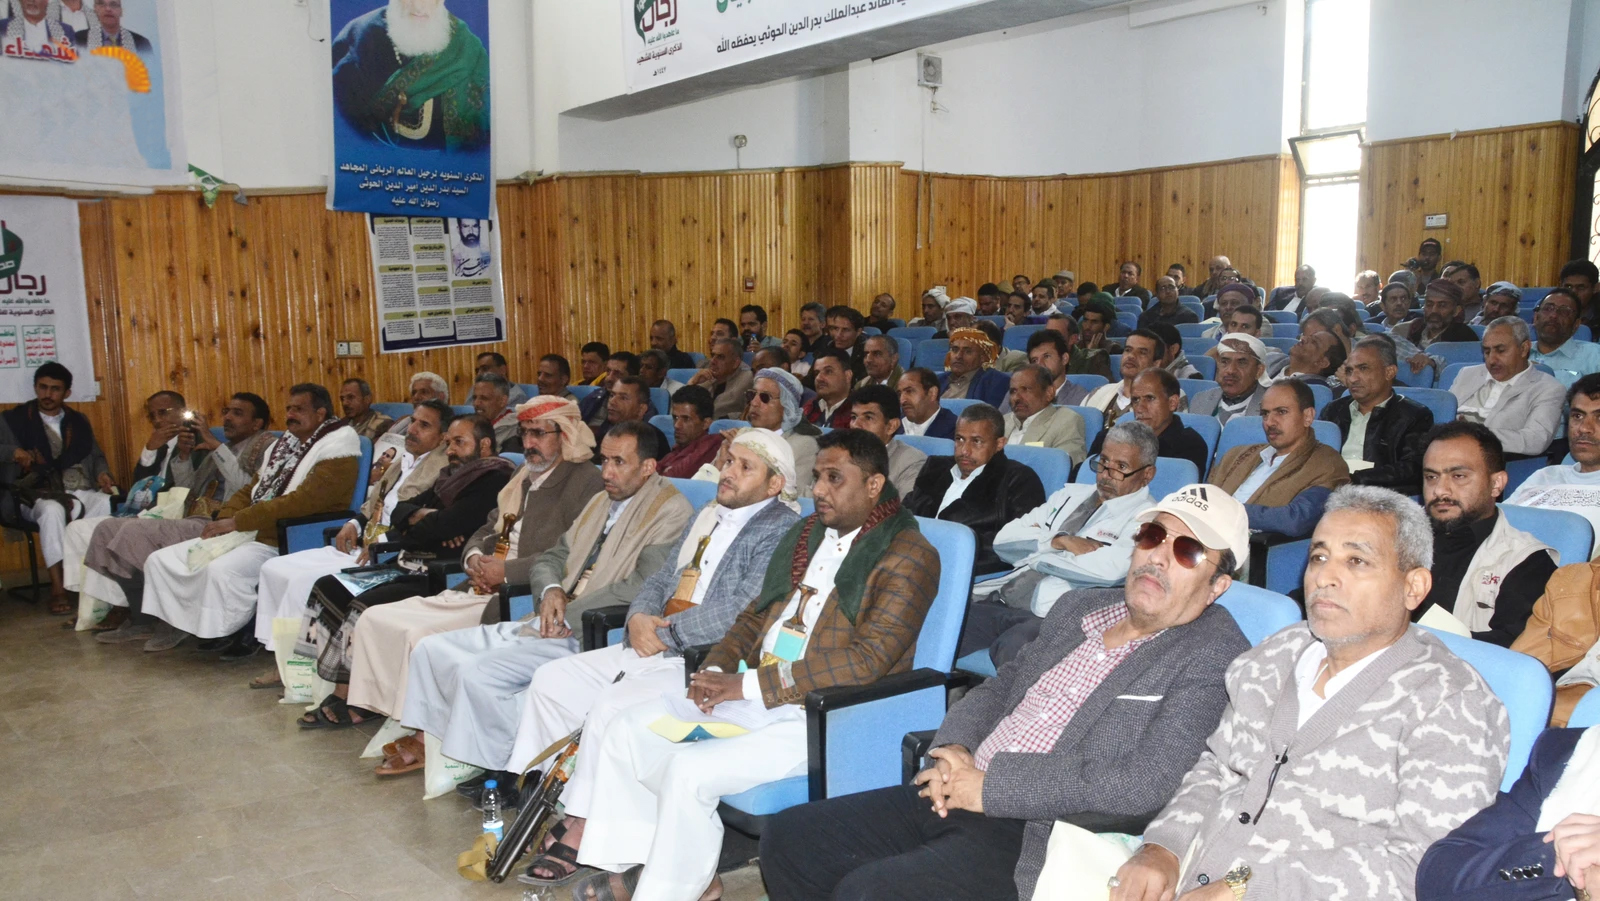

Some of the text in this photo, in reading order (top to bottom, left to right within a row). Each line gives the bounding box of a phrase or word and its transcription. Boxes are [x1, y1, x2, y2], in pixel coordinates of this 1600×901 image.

[788, 16, 809, 35] الدين
[810, 15, 822, 31] بدر
[758, 23, 787, 44] الحوثي
[717, 33, 730, 53] الله
[731, 34, 757, 49] يحفظه
[340, 163, 368, 173] المجاهد
[396, 168, 416, 176] العالم
[418, 170, 438, 179] لرحيل
[464, 174, 485, 182] الذكرى
[385, 181, 403, 191] الدين
[420, 184, 437, 194] الدين
[451, 186, 469, 195] السيد
[392, 196, 440, 208] رضوان الله عليه
[1172, 495, 1209, 512] adidas
